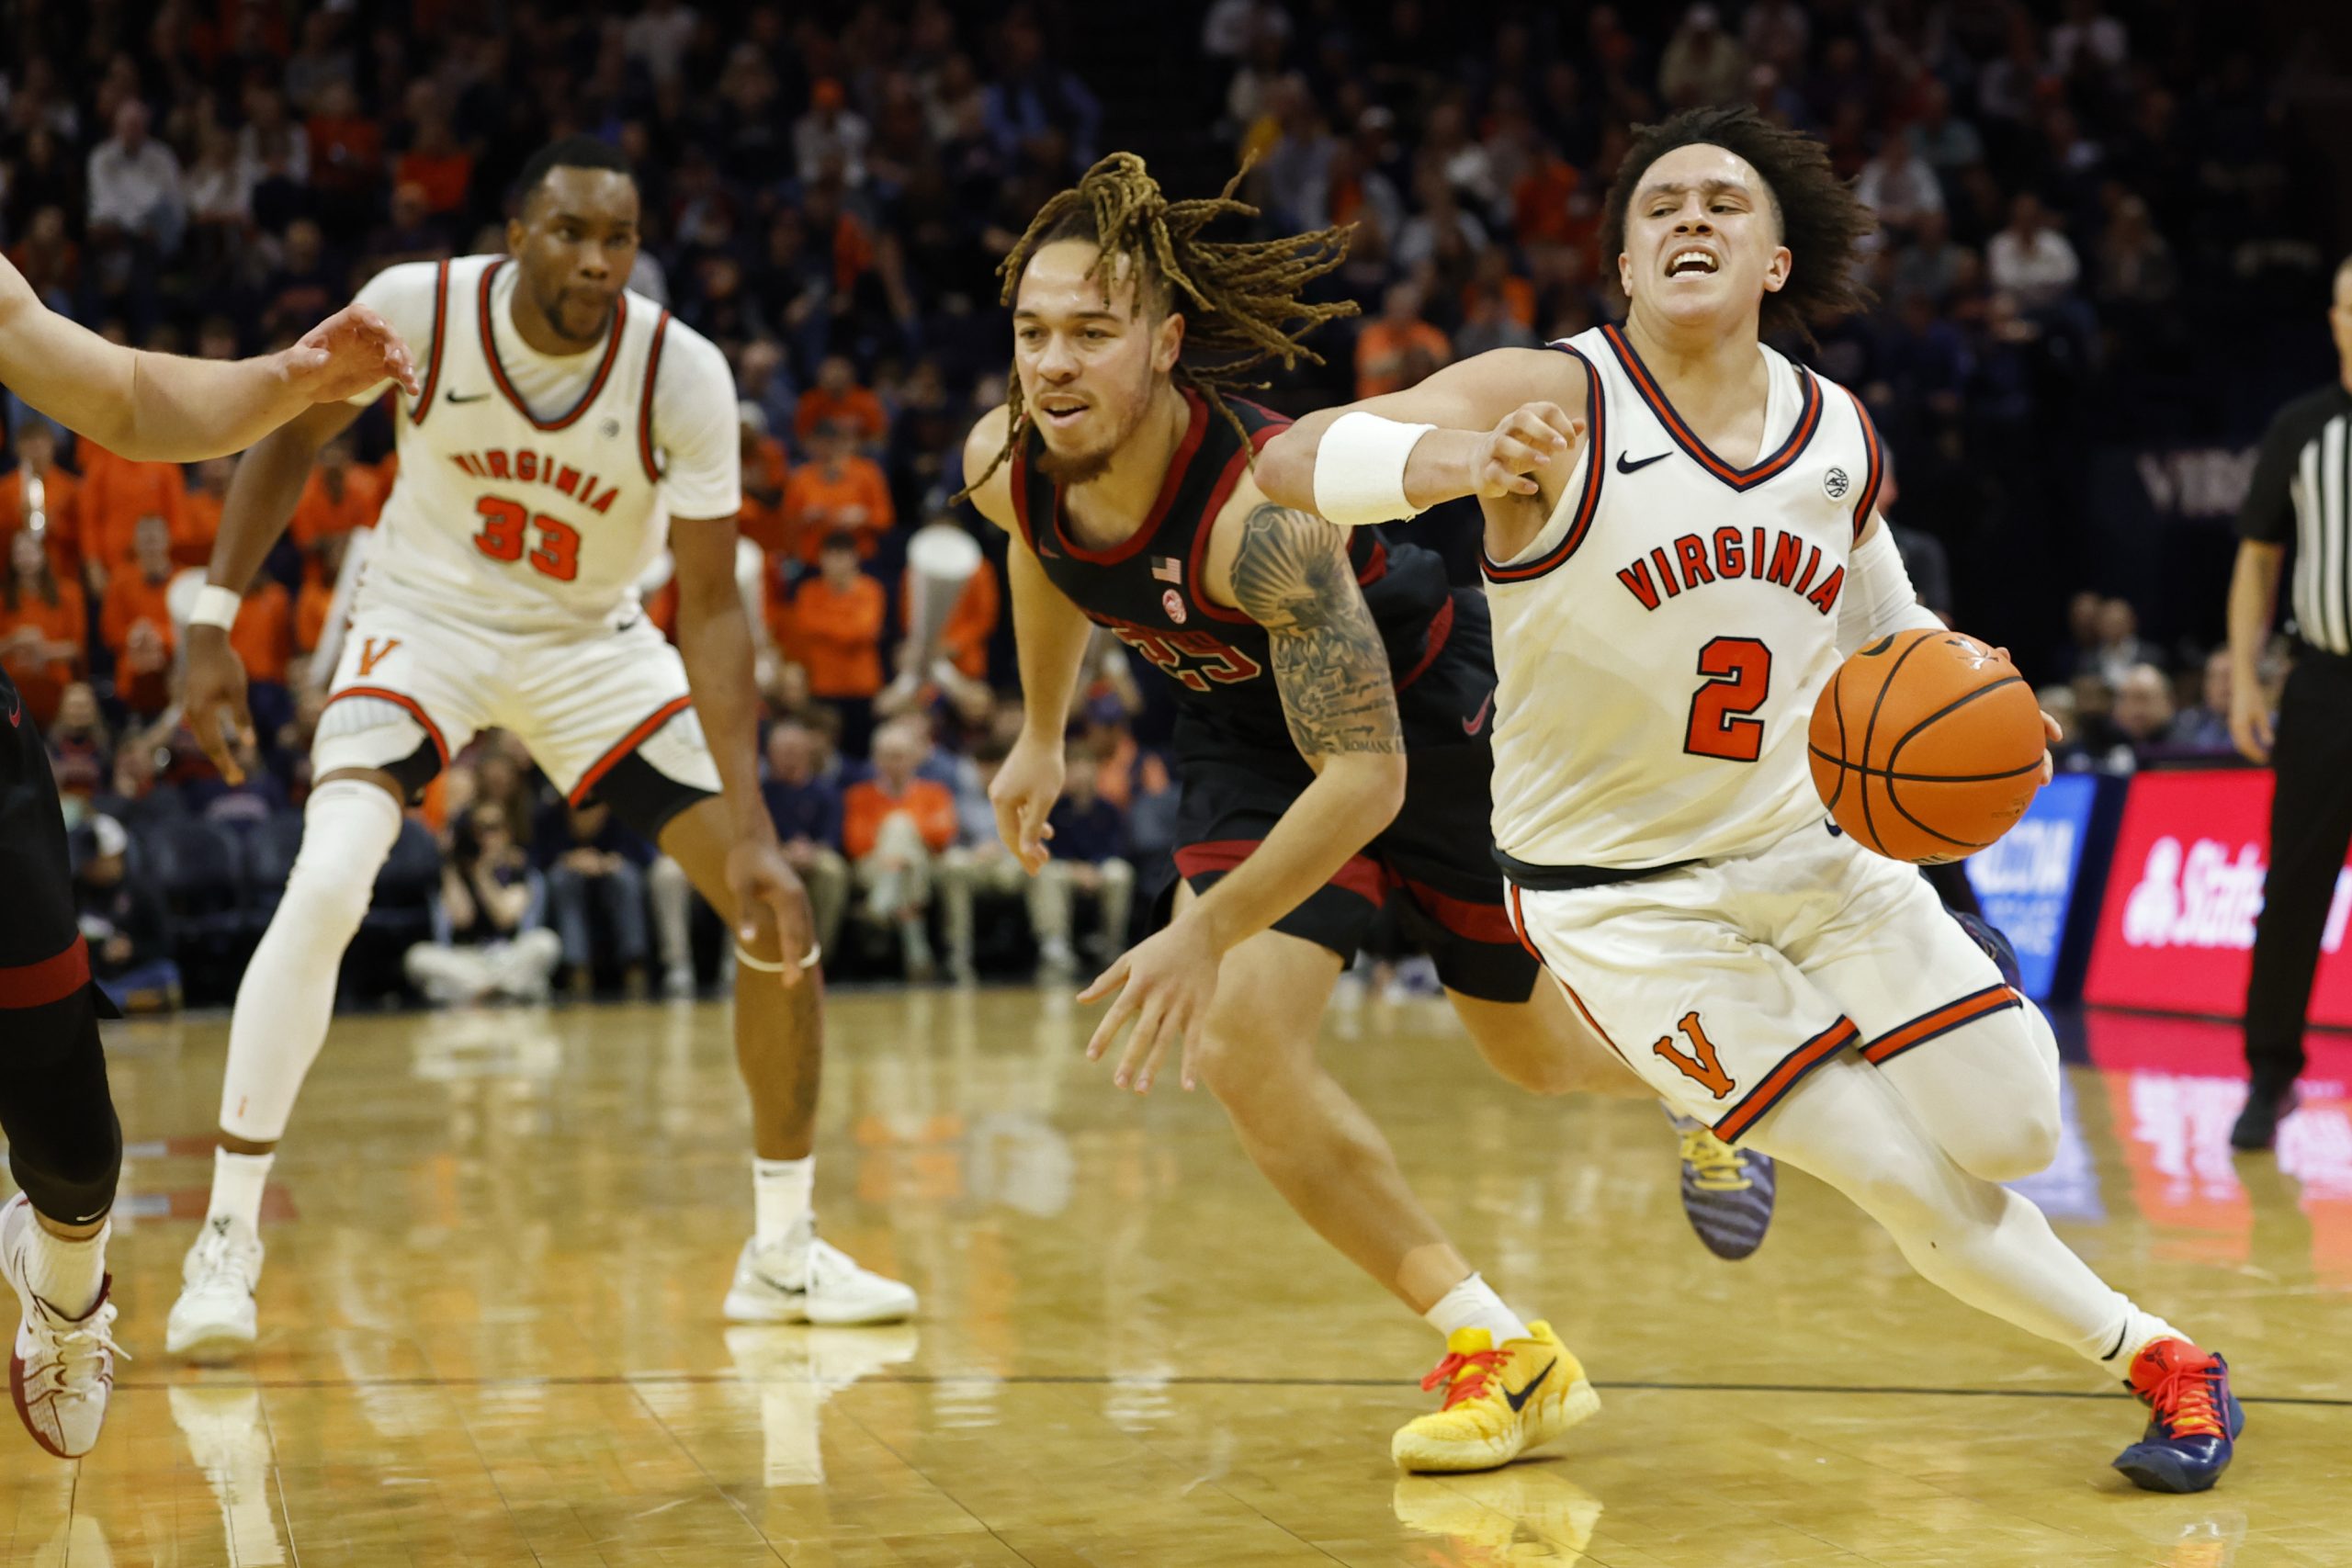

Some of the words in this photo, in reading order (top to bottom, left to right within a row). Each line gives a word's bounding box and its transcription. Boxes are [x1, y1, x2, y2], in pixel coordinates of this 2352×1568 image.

[449, 448, 619, 515] VIRGINIA
[473, 494, 581, 582] 33
[1616, 526, 1845, 615] VIRGINIA
[358, 637, 401, 676] V
[1683, 636, 1771, 762] 2
[1653, 1010, 1736, 1100] V
